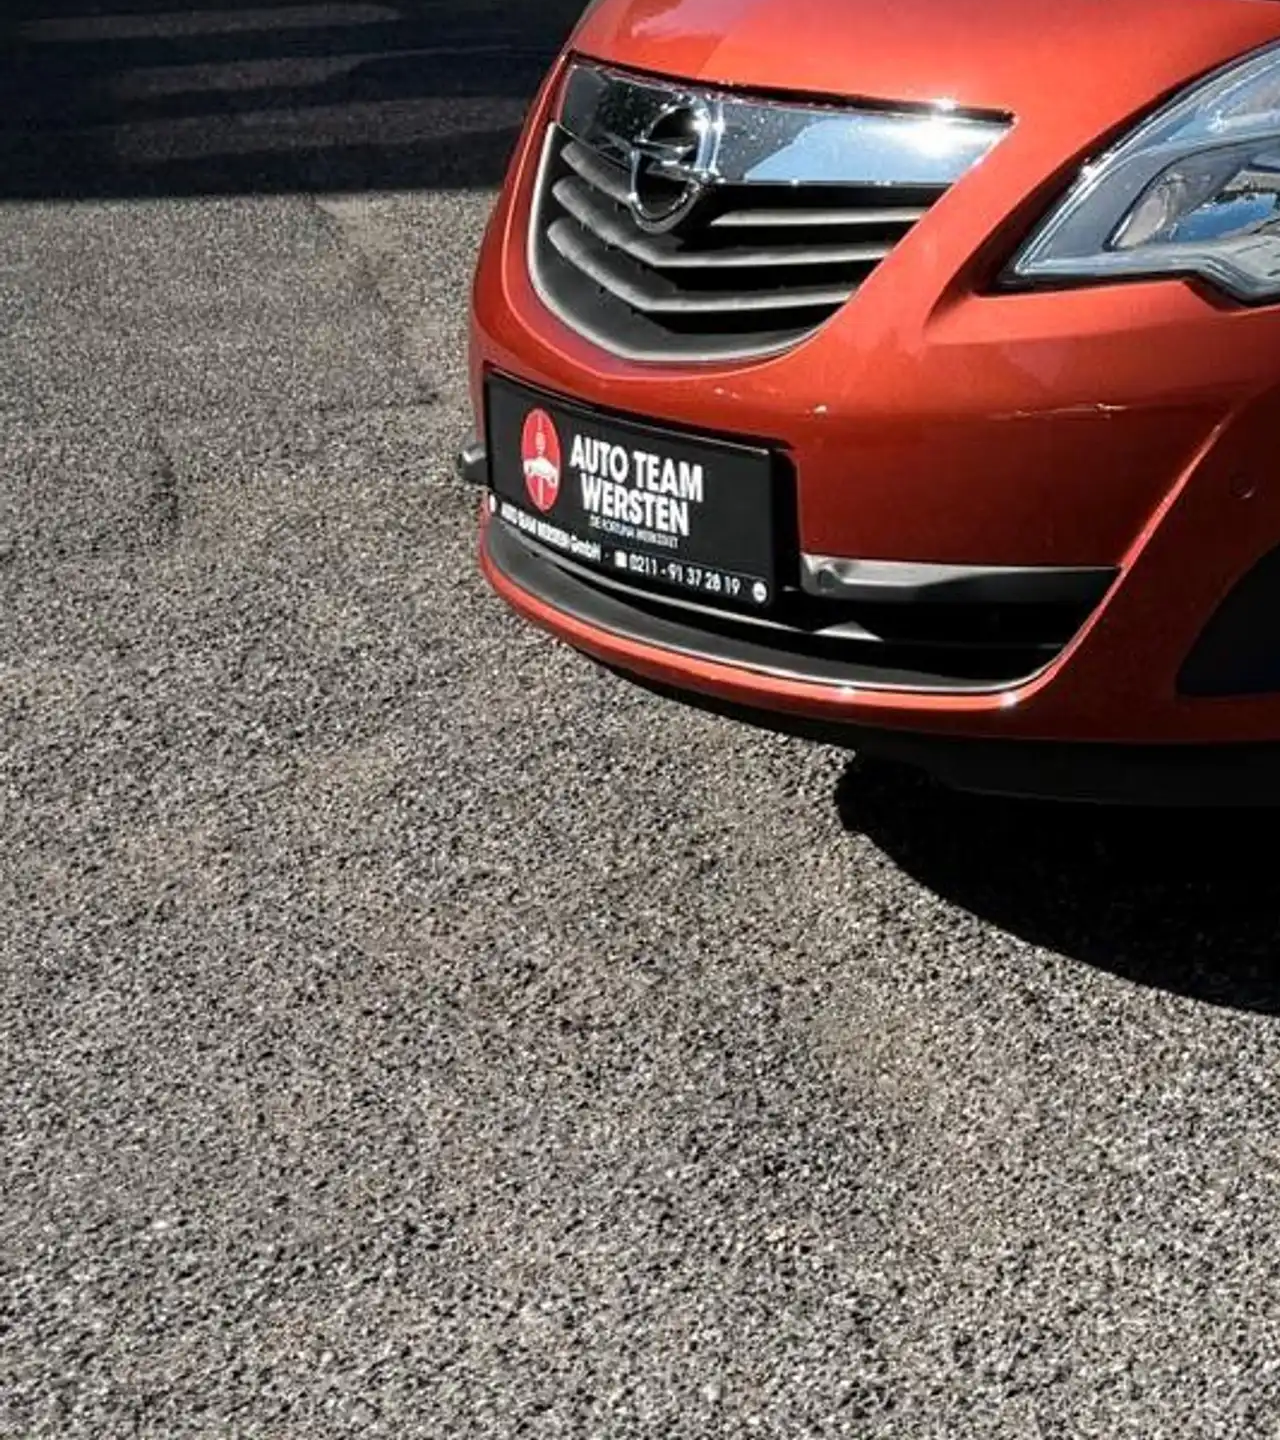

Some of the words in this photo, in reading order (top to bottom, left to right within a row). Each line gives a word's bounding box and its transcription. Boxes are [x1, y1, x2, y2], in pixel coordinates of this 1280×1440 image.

[569, 433, 629, 483] AUTO
[632, 450, 704, 503] TEAM
[580, 472, 690, 537] WERSTEN
[629, 554, 658, 577] 0211
[686, 567, 702, 587] 37
[725, 575, 741, 596] 19
